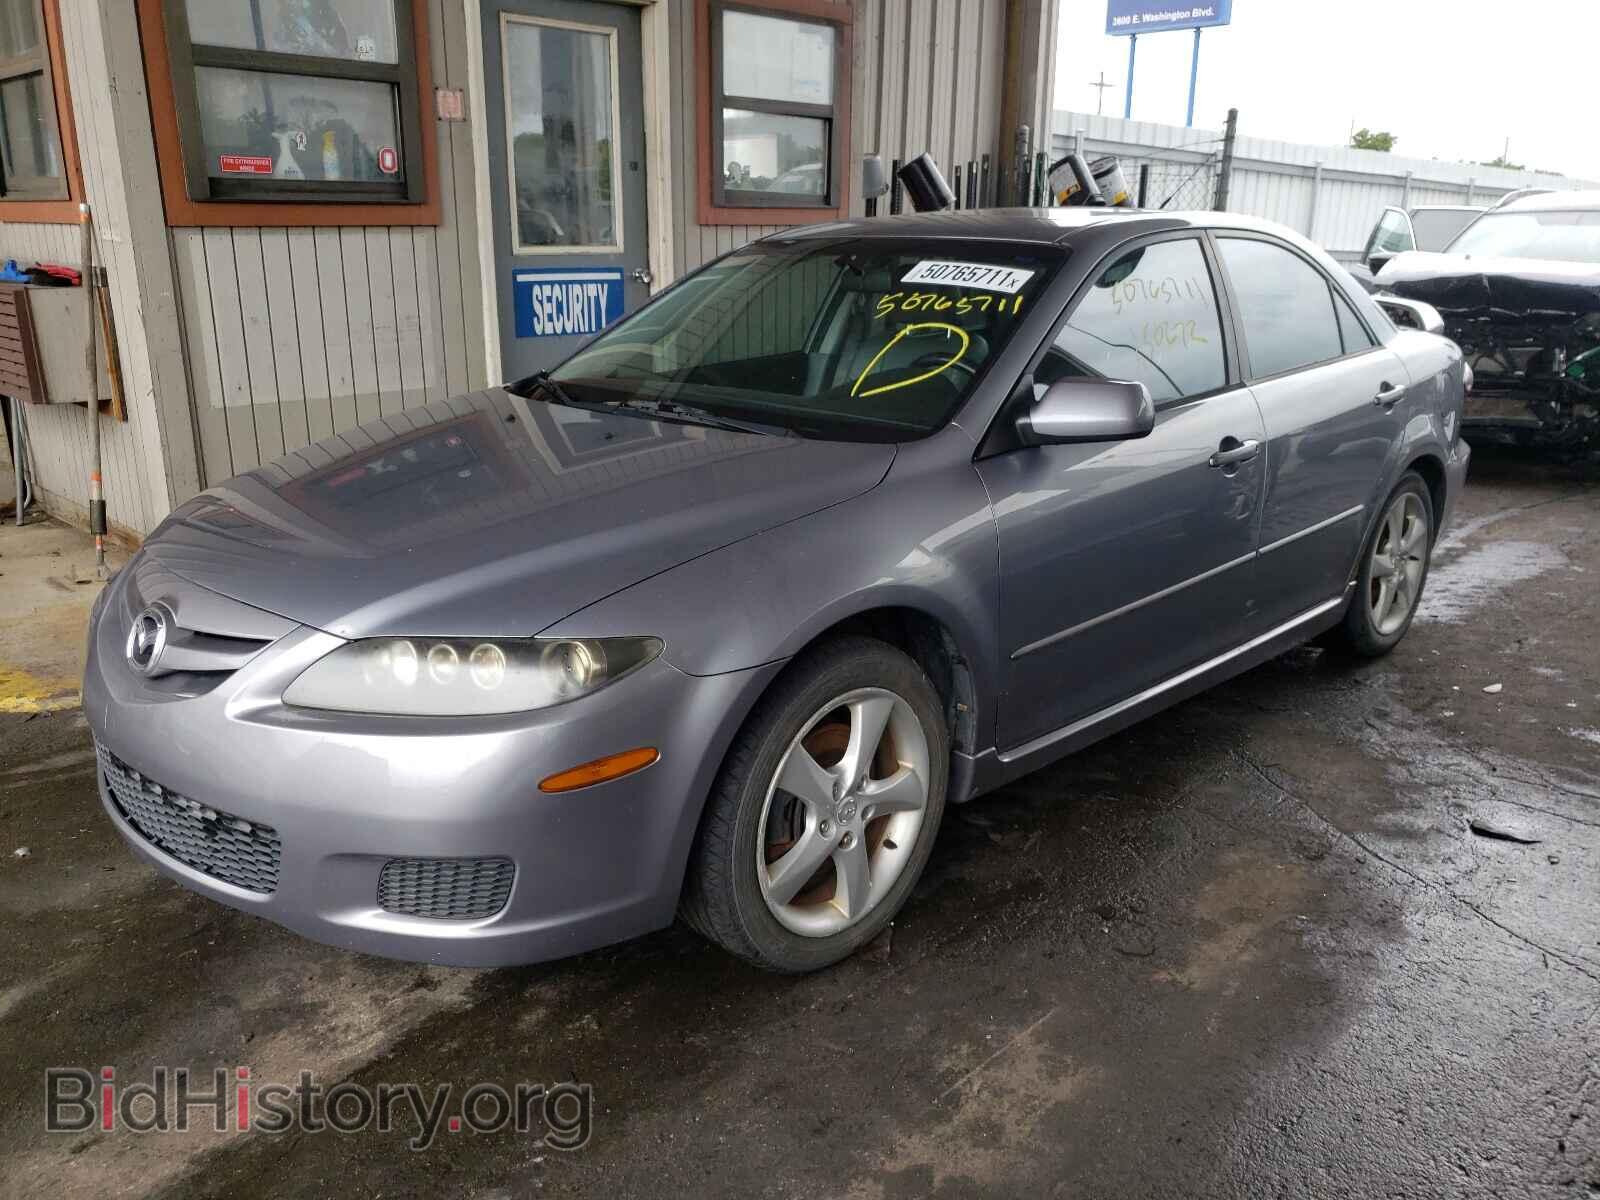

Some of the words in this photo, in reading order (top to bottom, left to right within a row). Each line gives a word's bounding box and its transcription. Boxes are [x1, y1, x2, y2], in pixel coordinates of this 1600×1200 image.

[1142, 10, 1190, 22] Washington
[1192, 7, 1214, 17] Blvd.
[532, 283, 608, 335] SECURITY
[874, 293, 1023, 318] 50765711
